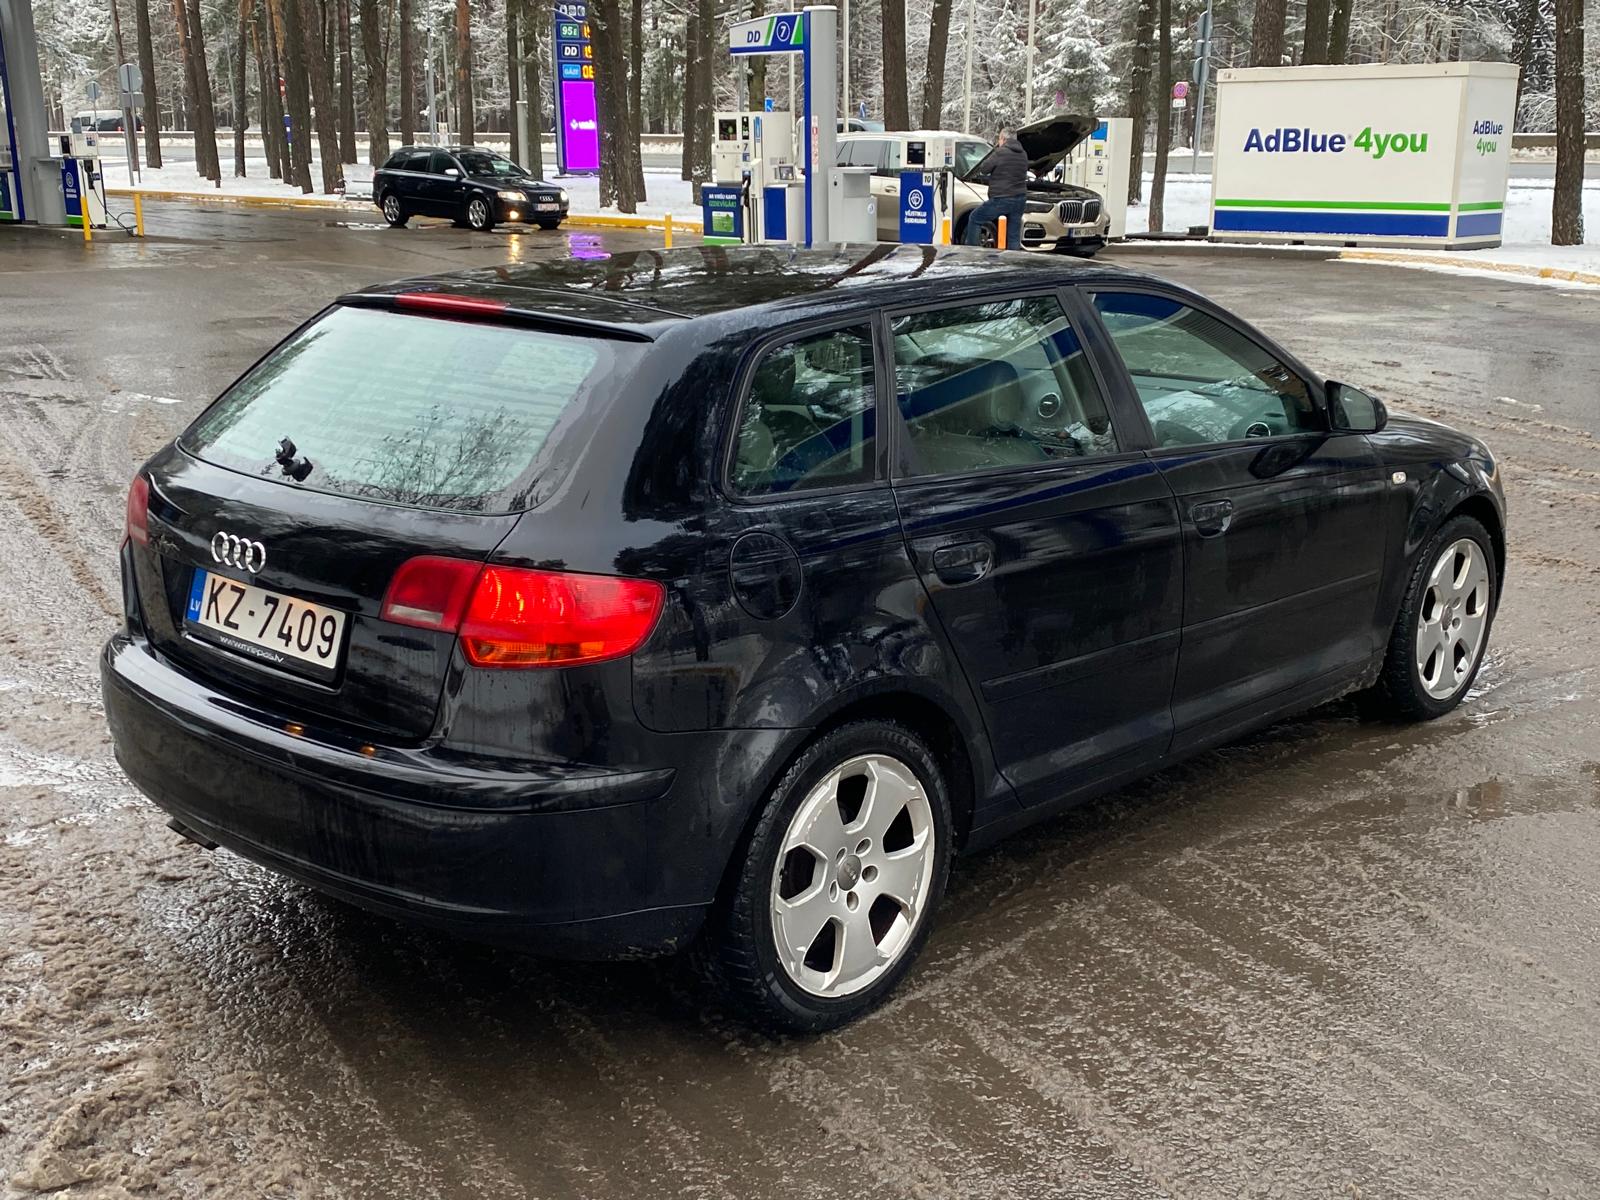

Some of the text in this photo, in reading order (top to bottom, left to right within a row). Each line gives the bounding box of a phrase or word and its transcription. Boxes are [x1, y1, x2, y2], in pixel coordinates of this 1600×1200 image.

[747, 31, 761, 43] DD
[564, 46, 577, 56] DD
[1472, 120, 1503, 135] AdBlue
[1243, 127, 1429, 159] AdBlue 4you
[1476, 138, 1497, 156] 4you
[190, 598, 201, 612] LV
[206, 578, 337, 659] KZ-7409
